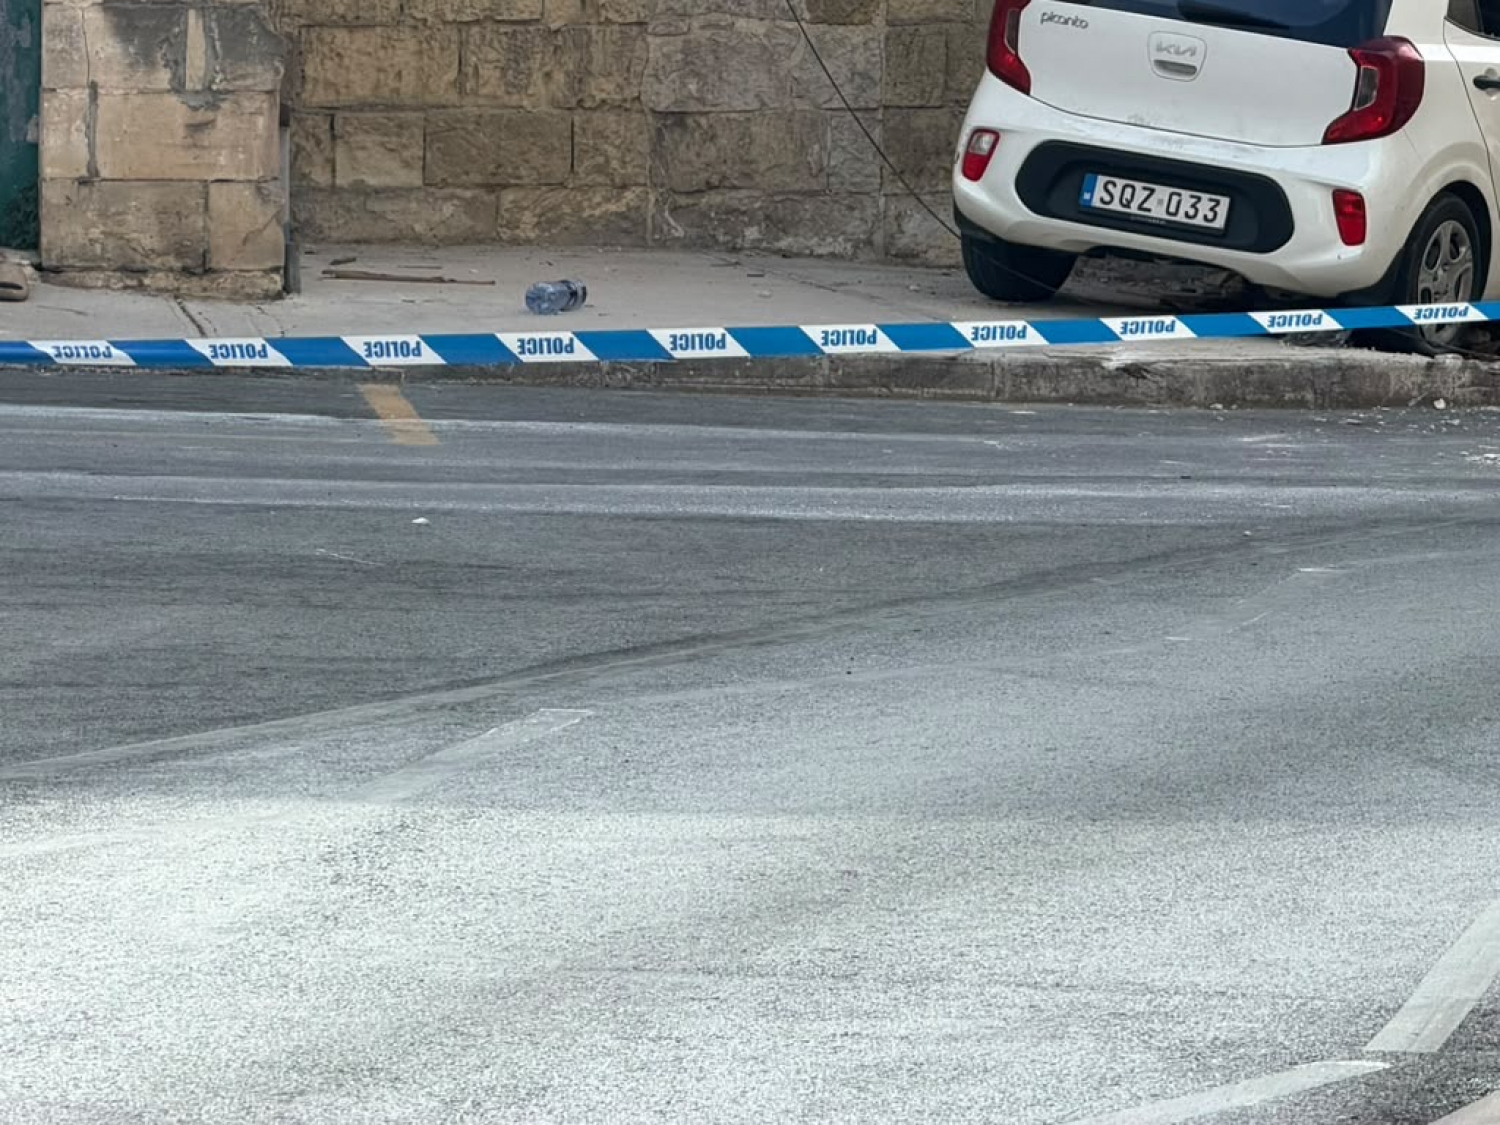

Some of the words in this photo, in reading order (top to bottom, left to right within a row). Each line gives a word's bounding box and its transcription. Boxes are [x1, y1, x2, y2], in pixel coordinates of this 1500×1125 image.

[1100, 180, 1156, 212] SQZ
[1166, 192, 1221, 223] 033
[1268, 313, 1323, 328] POLICE
[1414, 305, 1469, 320] POLICE
[971, 324, 1027, 341] POLICE
[1120, 320, 1176, 335] POLICE
[517, 337, 574, 354] POLICE
[669, 333, 726, 350] POLICE
[821, 329, 877, 346] POLICE
[51, 346, 114, 359] POLICE
[208, 343, 268, 360] POLICE
[363, 340, 422, 357] POLICE
